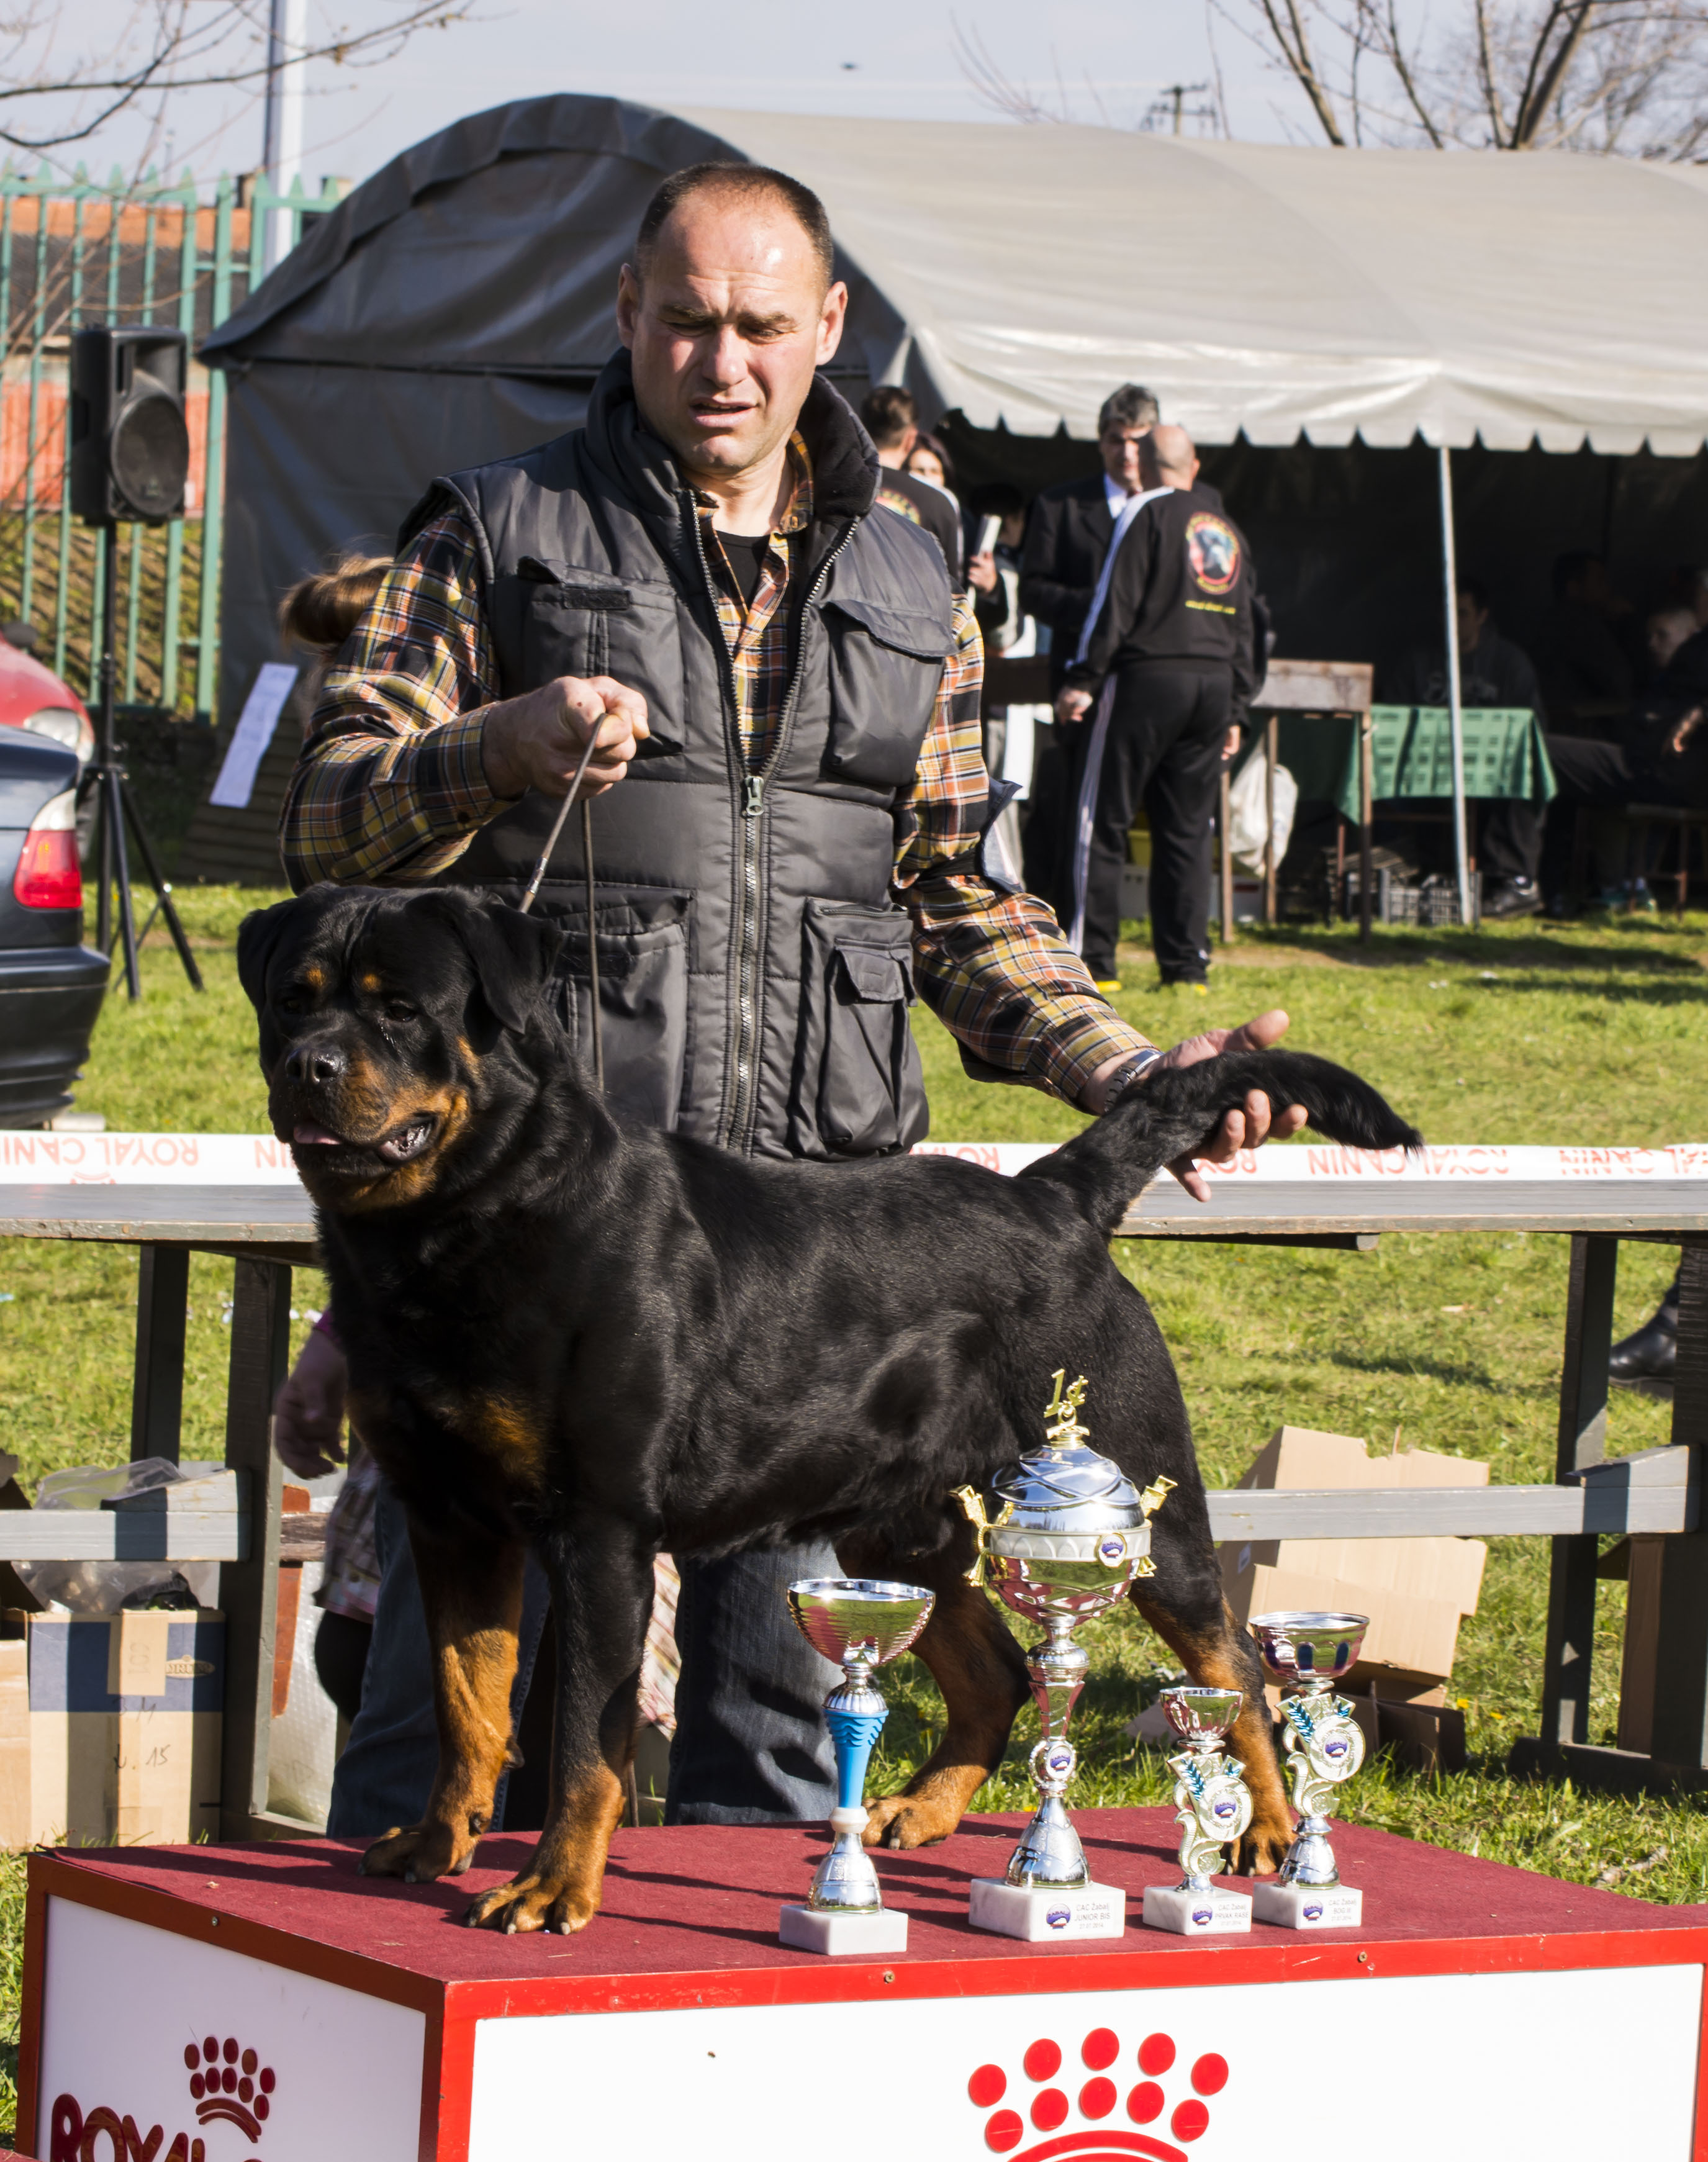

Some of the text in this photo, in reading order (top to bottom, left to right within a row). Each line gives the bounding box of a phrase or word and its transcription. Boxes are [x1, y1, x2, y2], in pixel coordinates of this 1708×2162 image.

[94, 1137, 199, 1167] ROYAL
[1306, 1148, 1407, 1175] CANIN
[1074, 1913, 1098, 1922] JUNIOR
